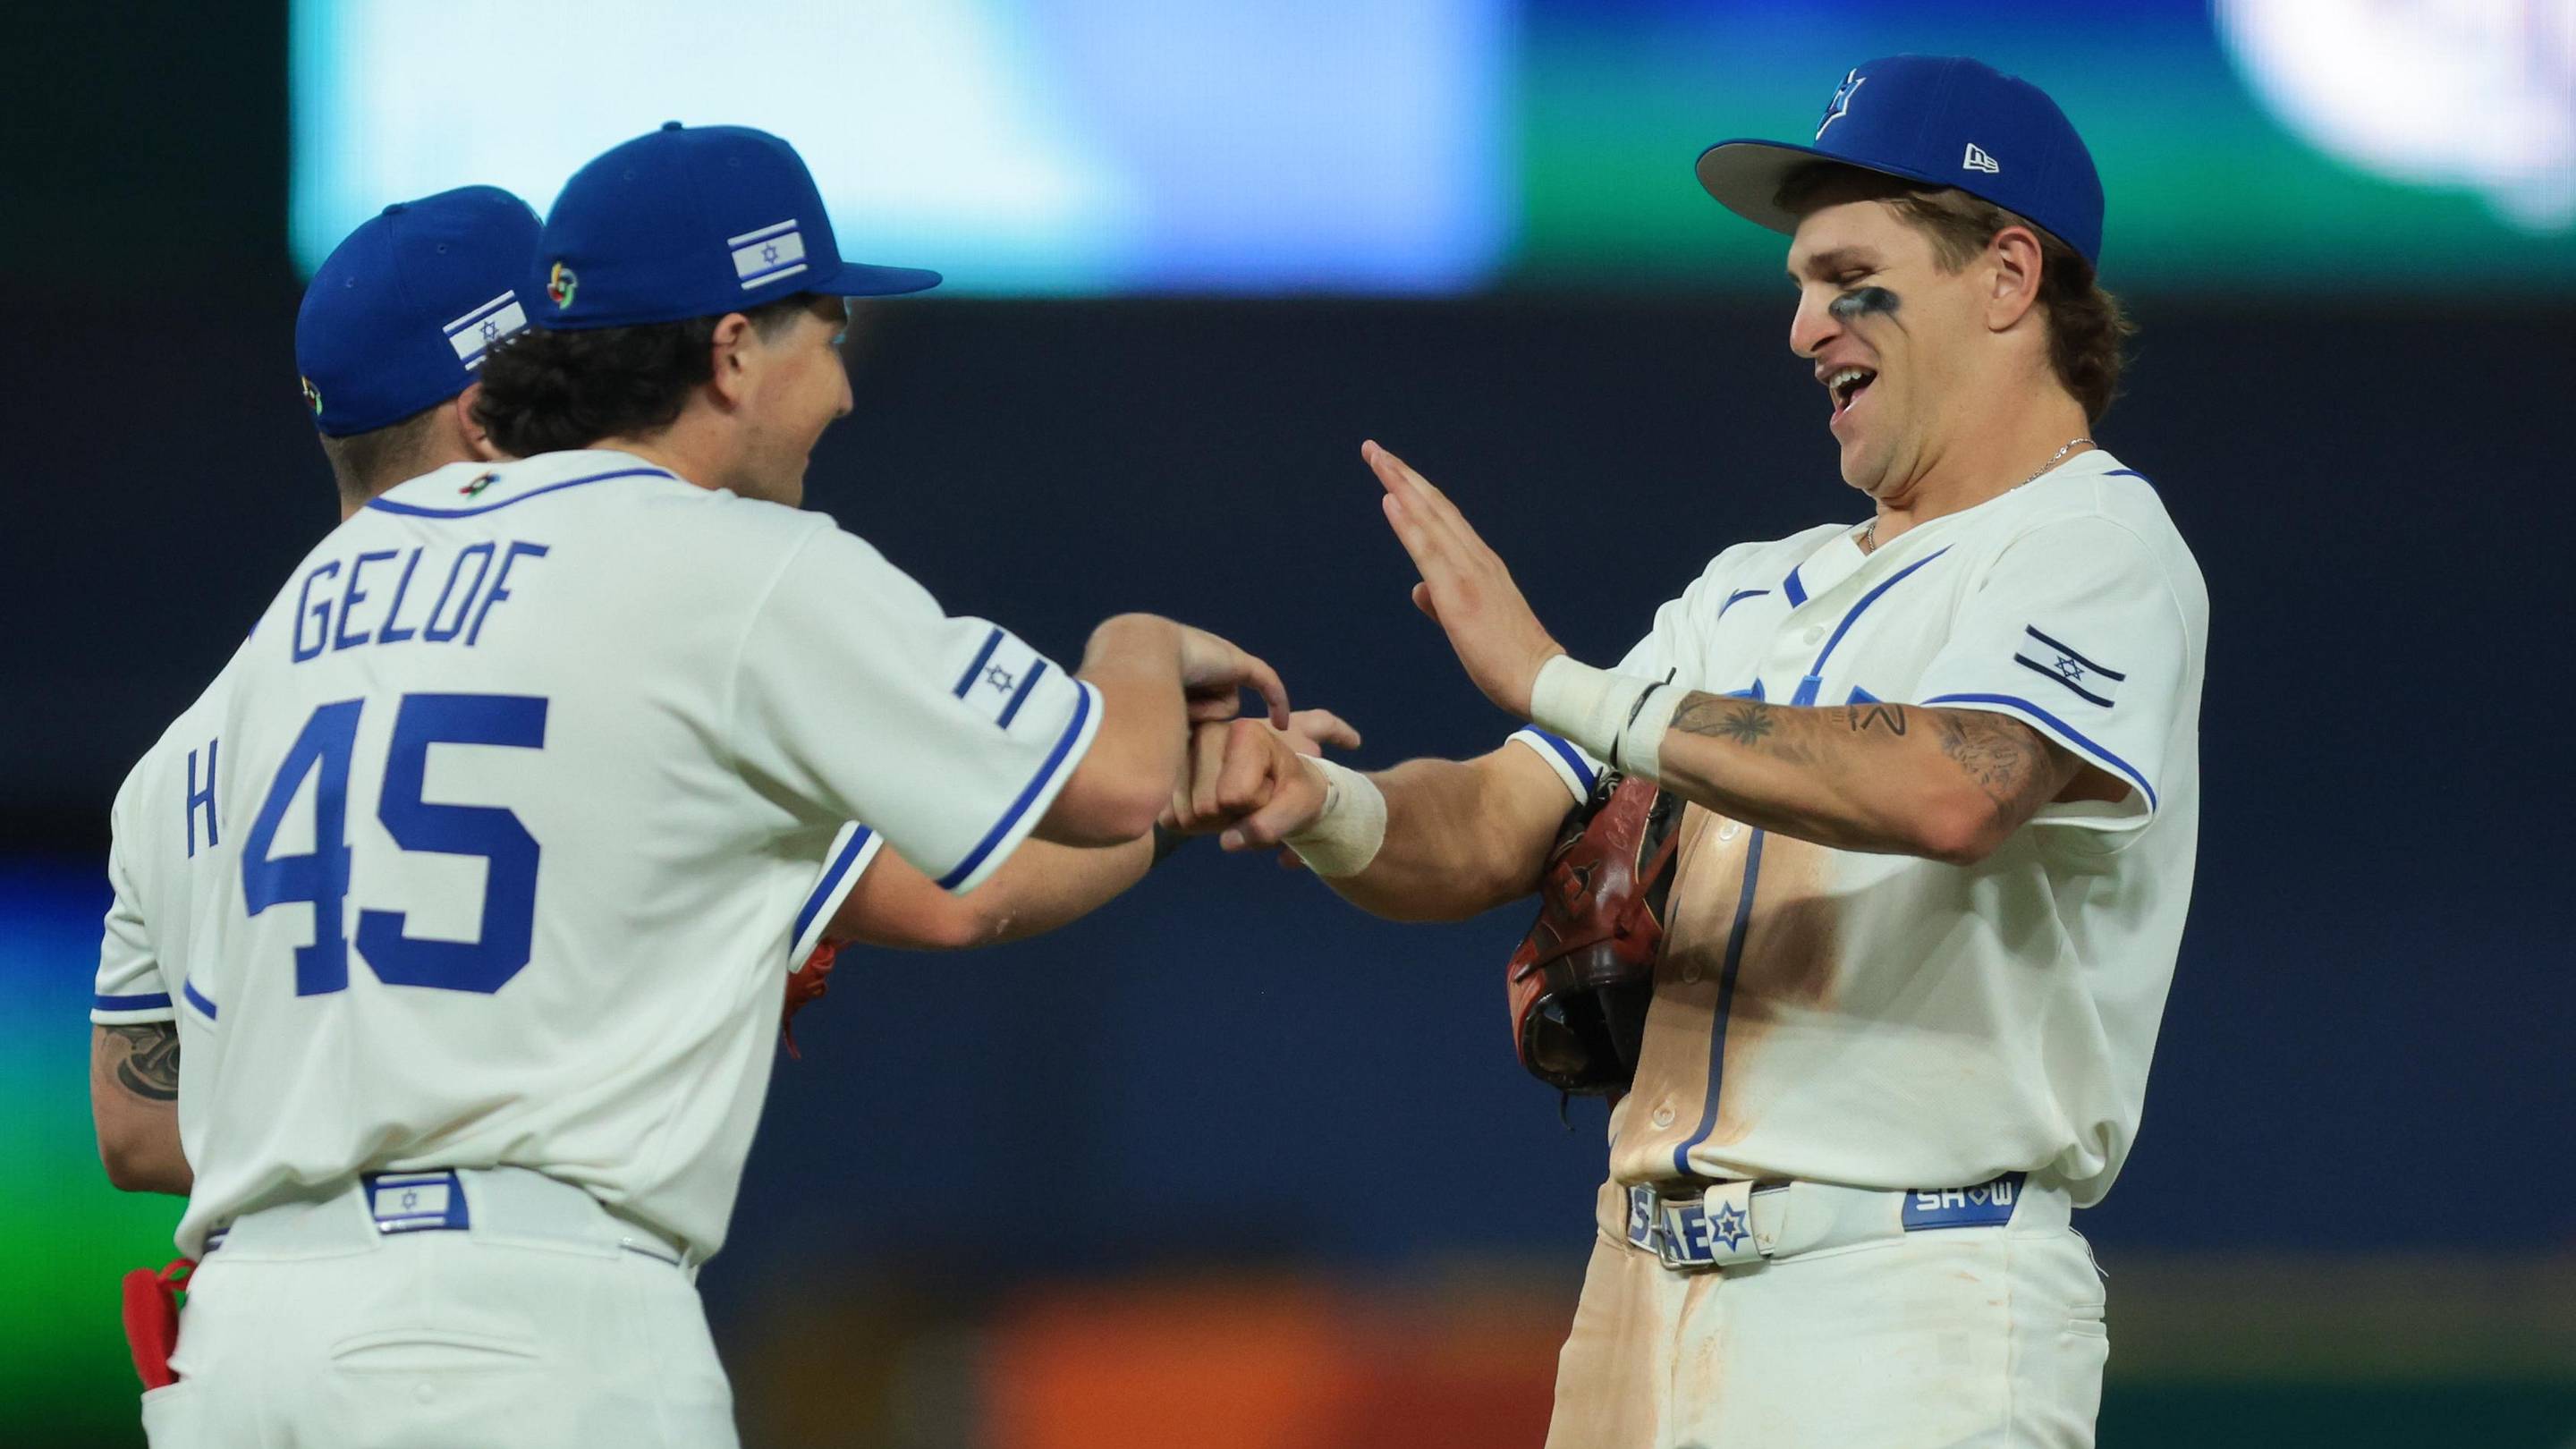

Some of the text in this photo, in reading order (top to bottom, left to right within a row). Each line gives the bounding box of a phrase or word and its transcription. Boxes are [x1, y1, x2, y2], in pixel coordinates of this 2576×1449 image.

[292, 540, 549, 664] GELOF
[186, 736, 218, 860] H
[241, 691, 548, 996] 45
